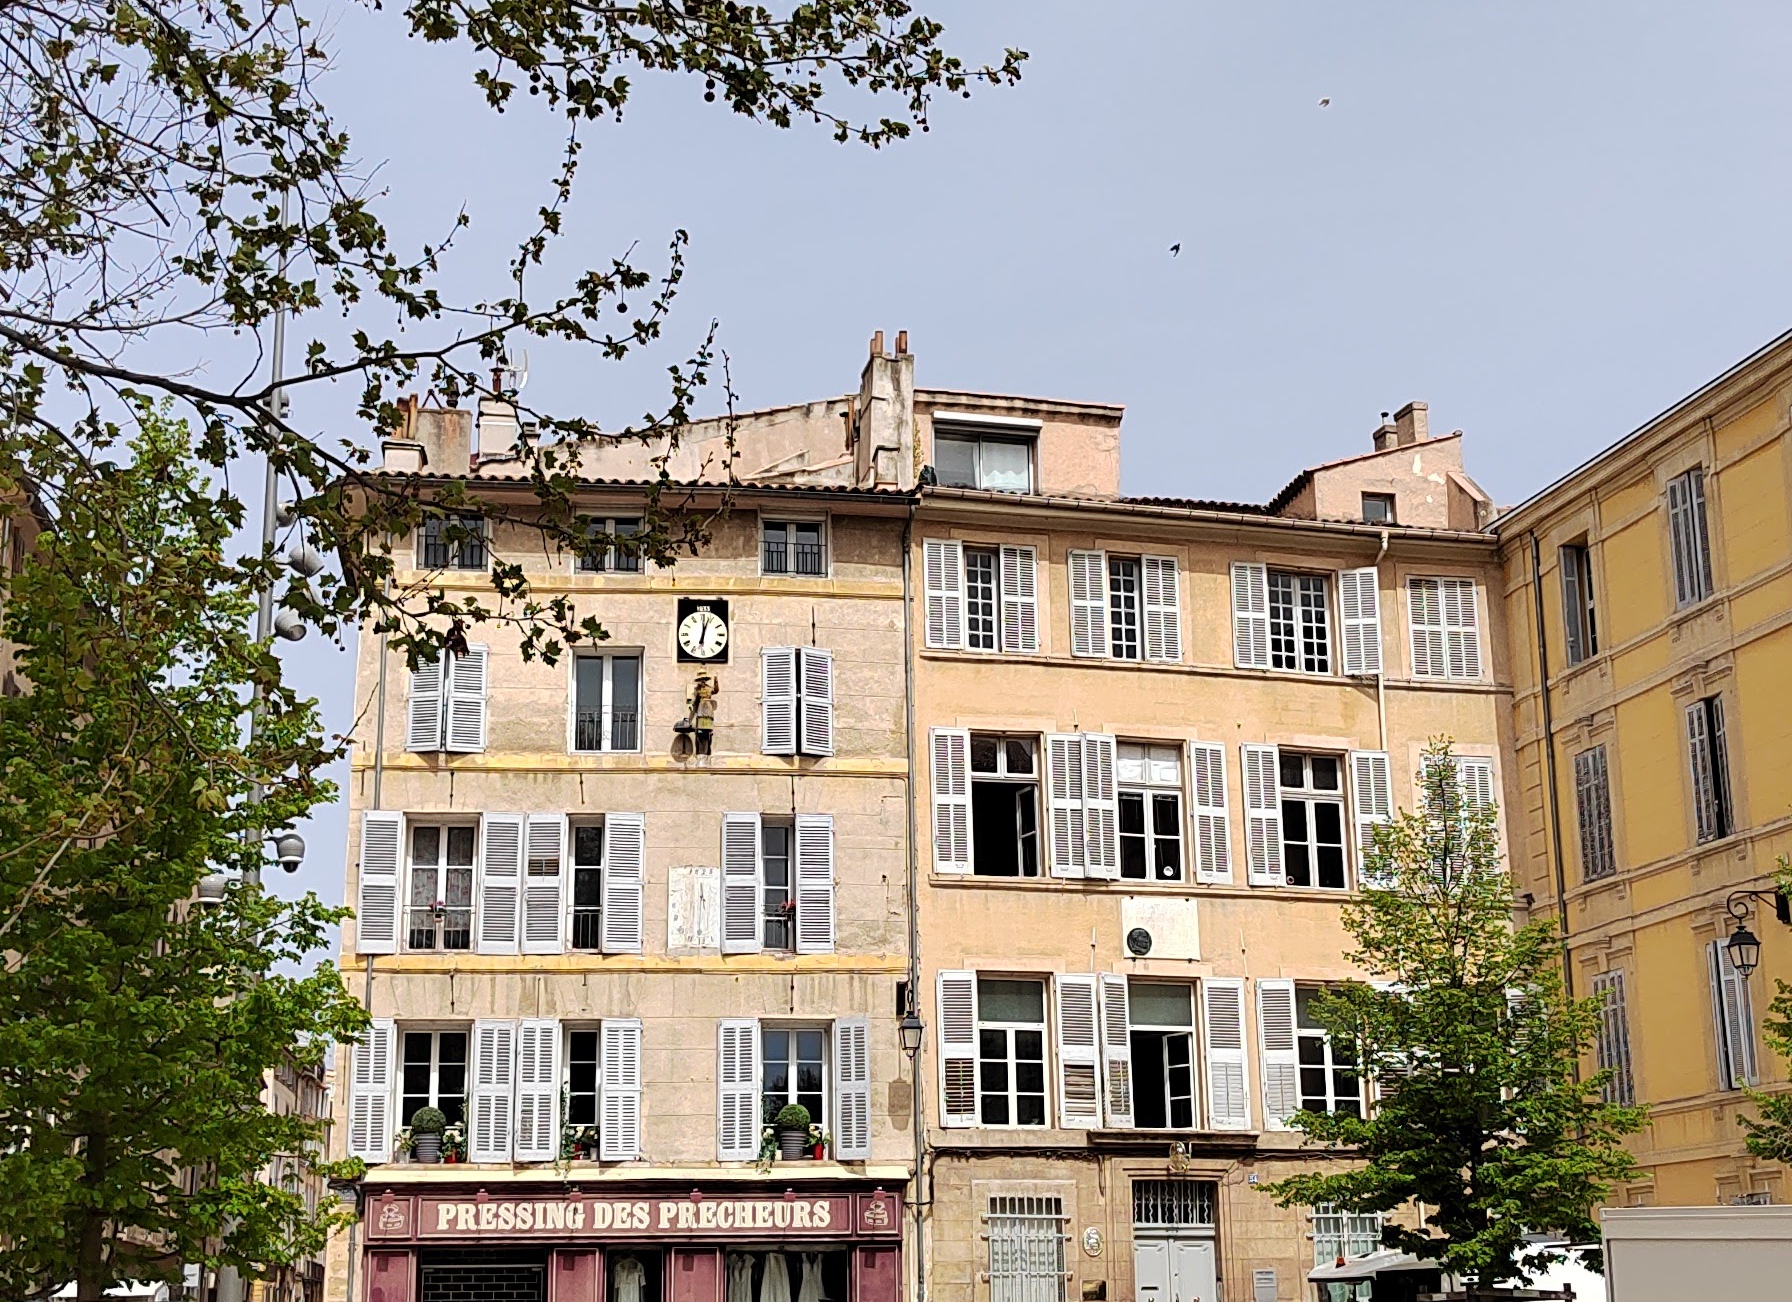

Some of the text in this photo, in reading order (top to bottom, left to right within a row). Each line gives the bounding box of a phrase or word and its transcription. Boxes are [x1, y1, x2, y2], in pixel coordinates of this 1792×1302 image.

[436, 1201, 831, 1230] PRESSING DES PRECHEURS
